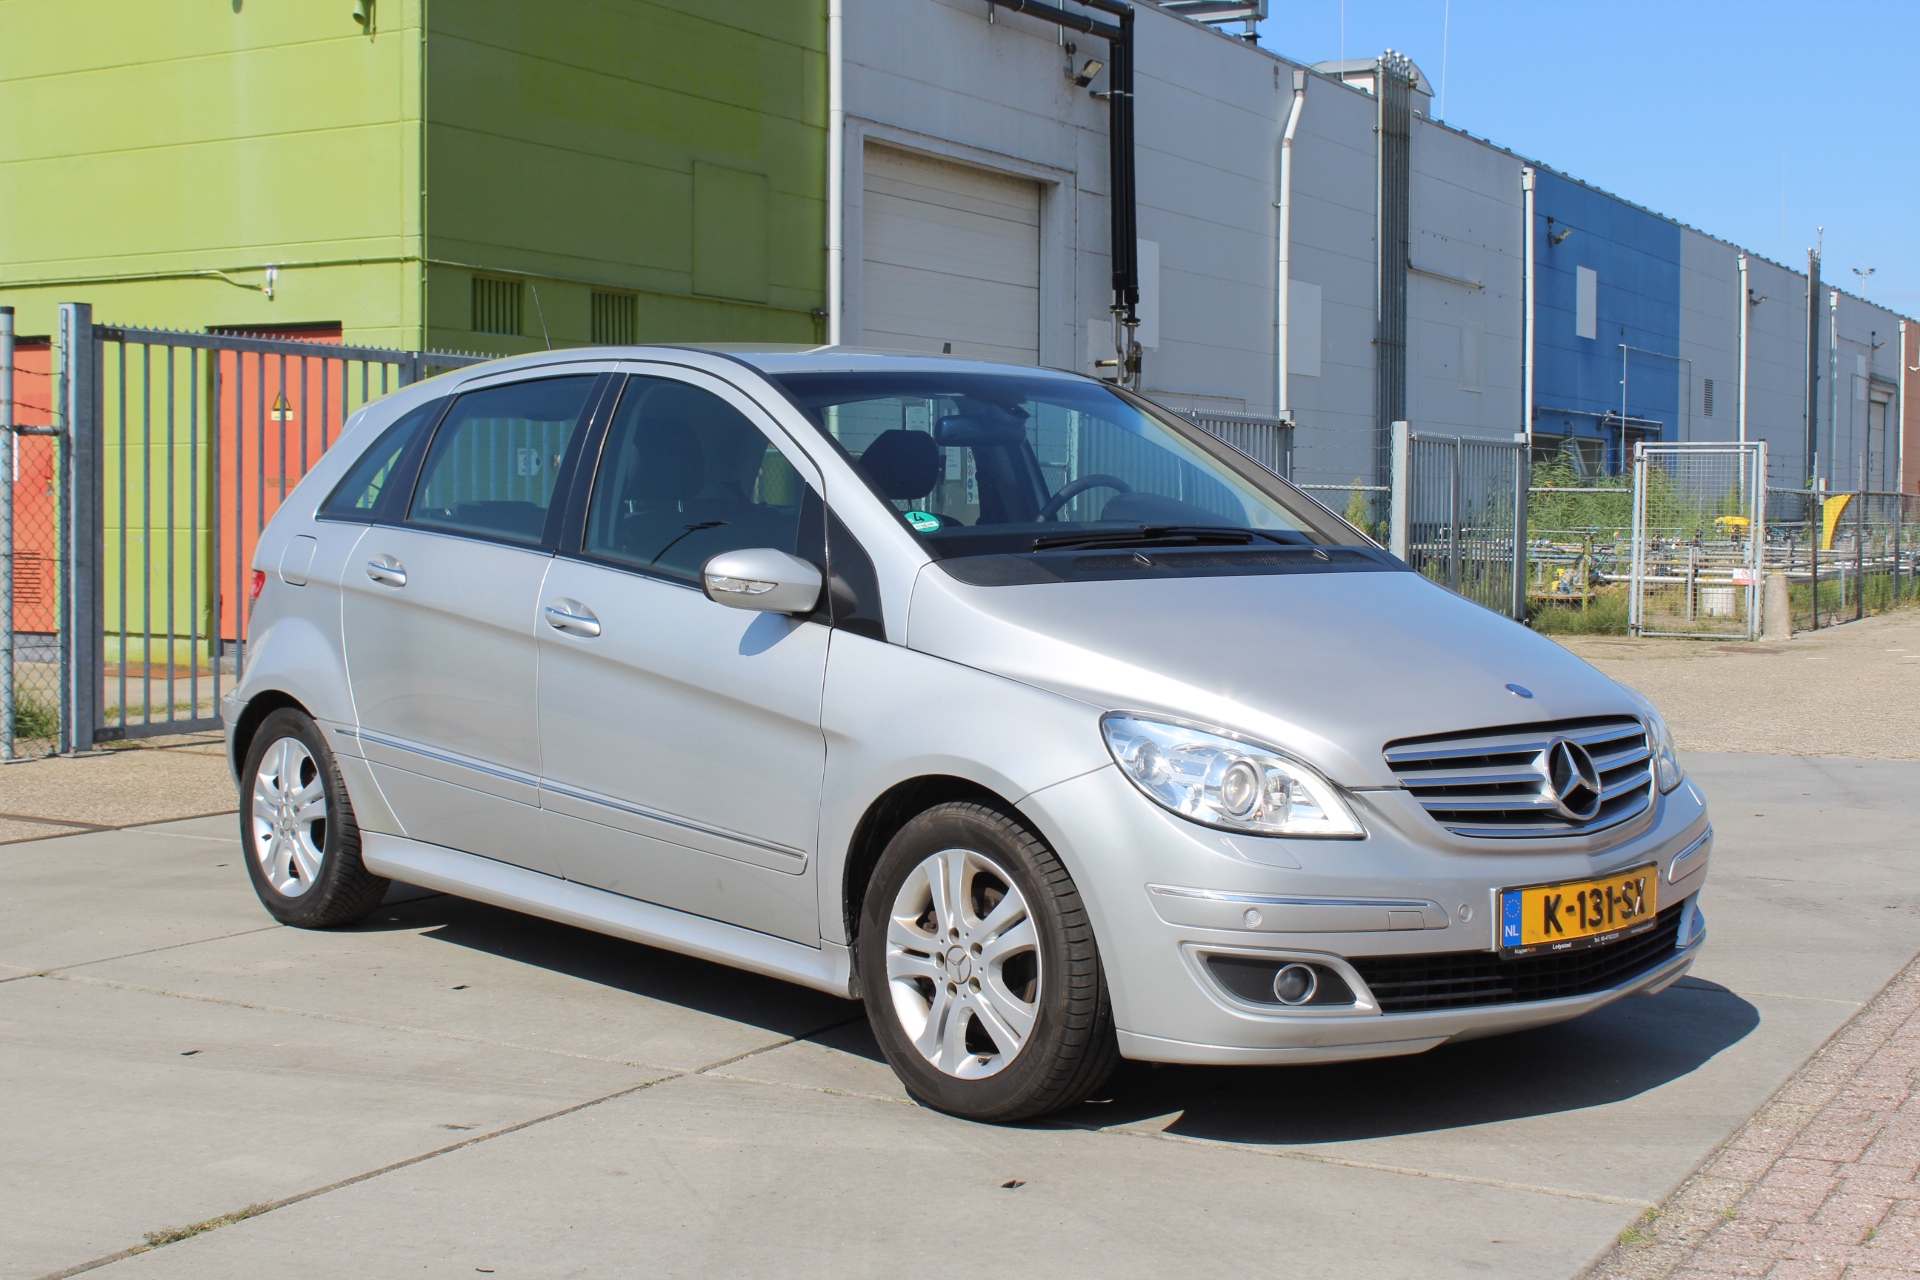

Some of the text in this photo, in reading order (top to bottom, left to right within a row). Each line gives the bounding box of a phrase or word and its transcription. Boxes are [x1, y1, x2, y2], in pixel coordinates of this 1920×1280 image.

[913, 512, 925, 521] 4
[1544, 877, 1646, 934] K-131-SX
[1505, 924, 1519, 938] NL
[1552, 942, 1572, 950] Lelystad
